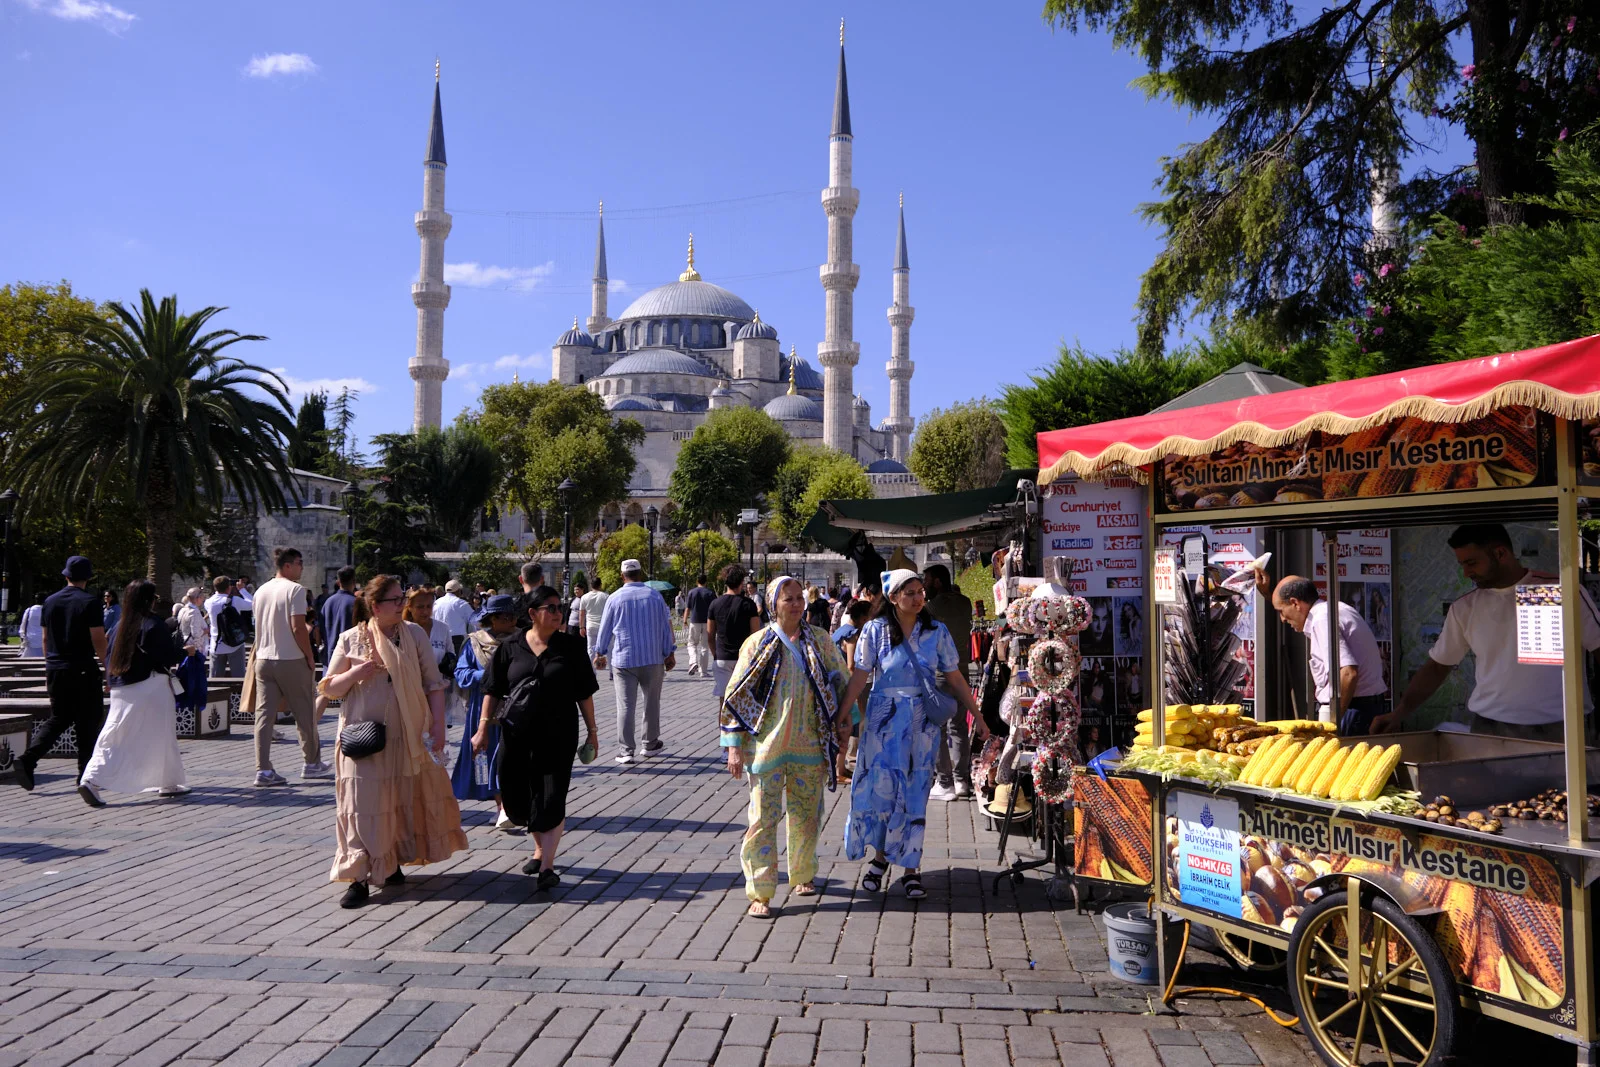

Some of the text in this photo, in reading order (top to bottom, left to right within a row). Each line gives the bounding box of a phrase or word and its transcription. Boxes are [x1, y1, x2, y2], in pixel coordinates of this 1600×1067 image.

[1183, 462, 1244, 487] Sultan
[1249, 454, 1320, 480] Ahmet
[1390, 436, 1504, 466] Kestane
[1060, 500, 1122, 513] Cumhuriyet
[1060, 538, 1093, 548] Radikal
[1119, 577, 1142, 590] aki
[1164, 576, 1172, 590] TL
[1184, 833, 1233, 852] BÜYÜKŞEHİR
[1251, 809, 1327, 848] Ahmet
[1403, 836, 1526, 890] Kestane
[1188, 855, 1232, 876] NO:MK/65
[1190, 870, 1231, 891] İBRAHİM ÇELİK
